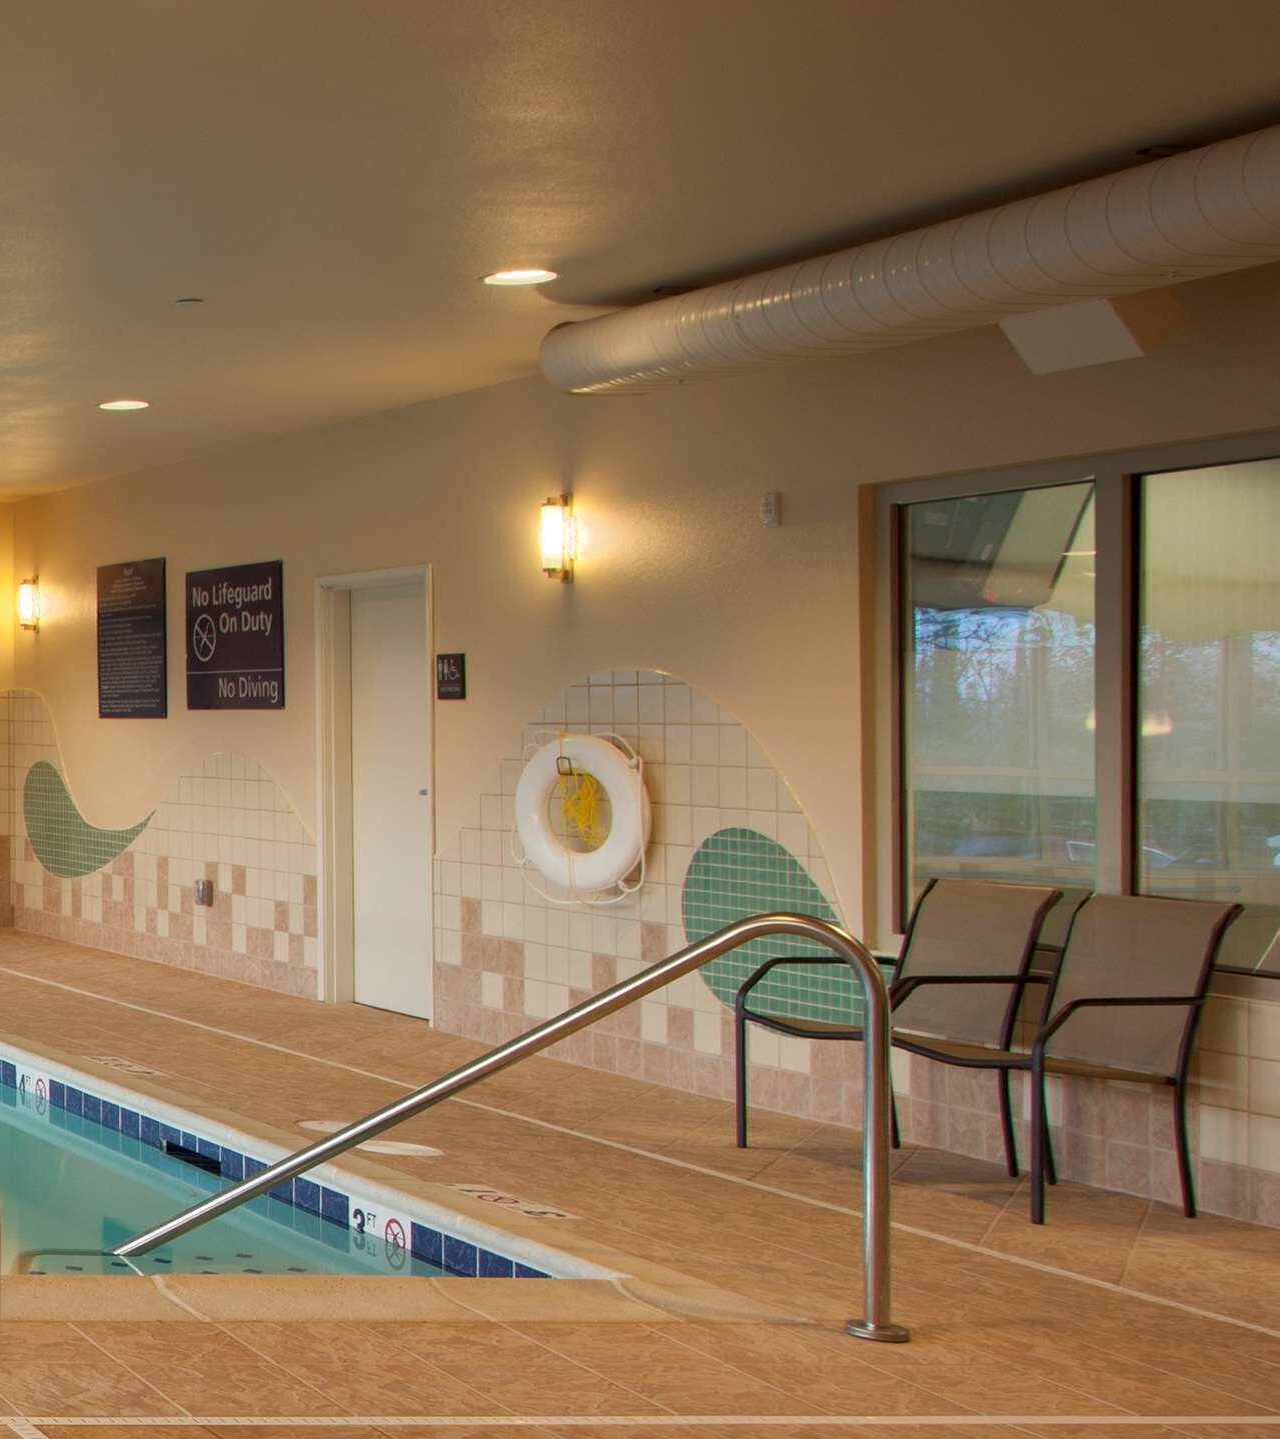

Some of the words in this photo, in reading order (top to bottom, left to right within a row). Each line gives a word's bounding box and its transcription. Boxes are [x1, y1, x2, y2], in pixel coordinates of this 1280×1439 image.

[192, 587, 209, 607] No
[212, 577, 272, 609] Lifeguard
[219, 612, 237, 633] On
[241, 611, 273, 636] Duty
[218, 677, 236, 698] No
[239, 675, 278, 703] Diving
[367, 1212, 376, 1229] FT
